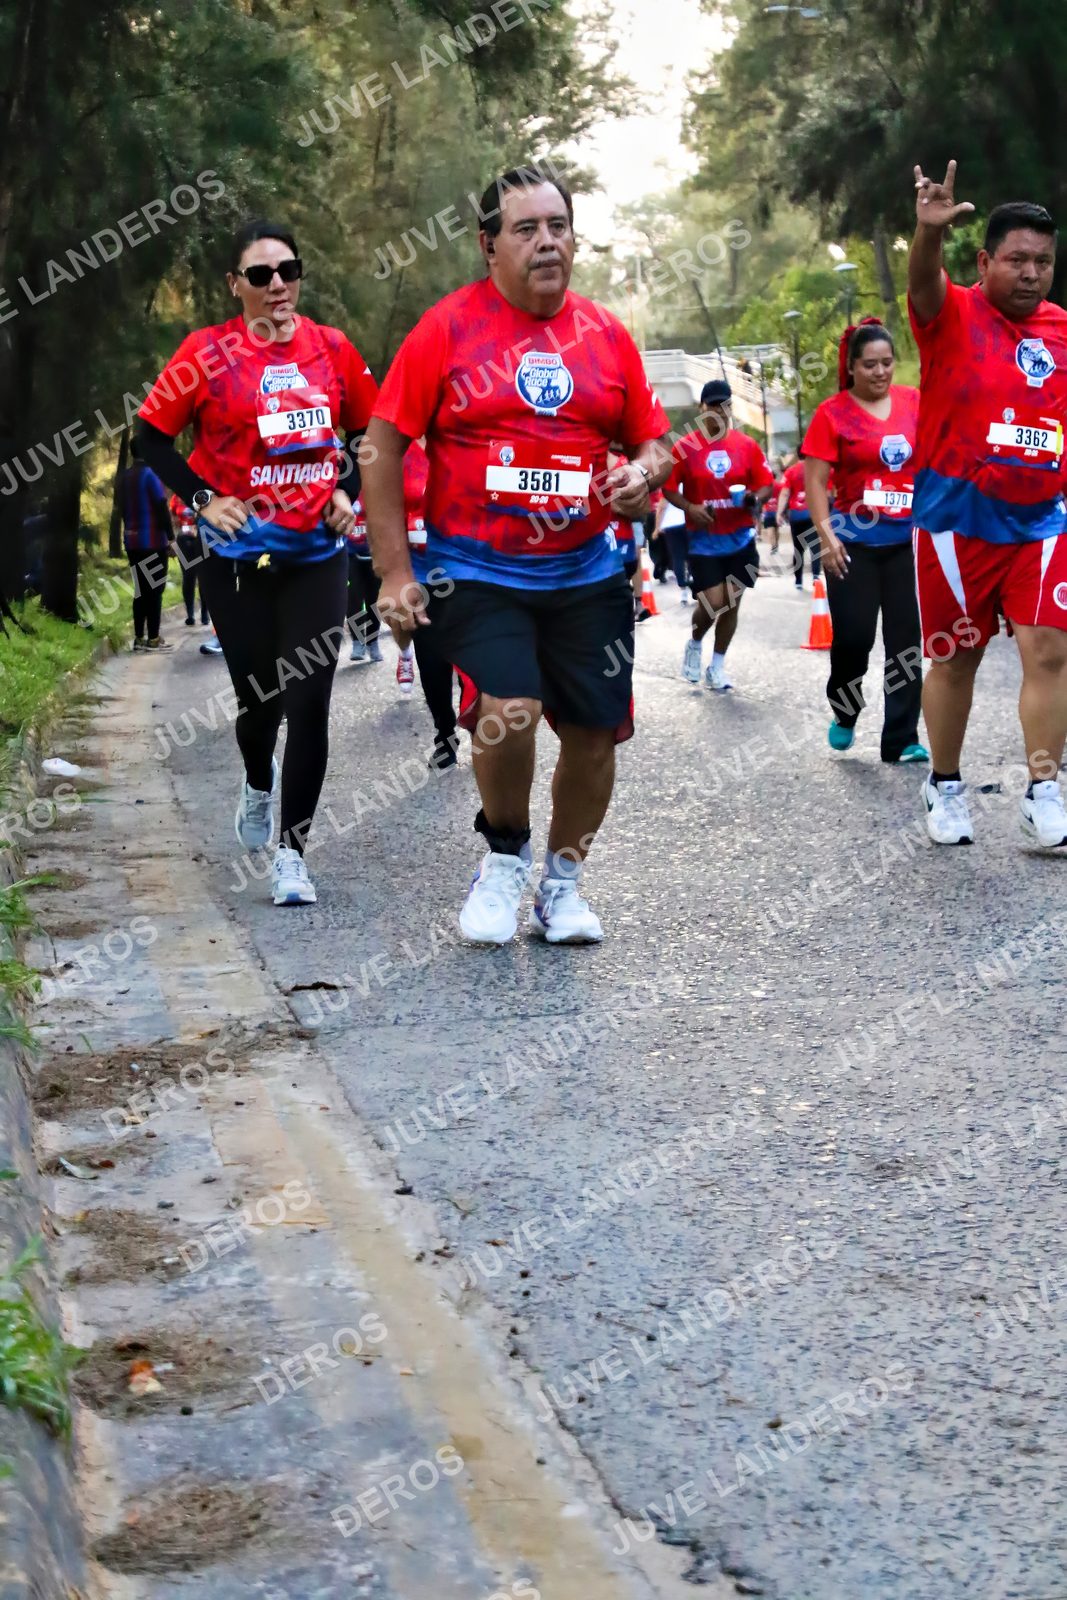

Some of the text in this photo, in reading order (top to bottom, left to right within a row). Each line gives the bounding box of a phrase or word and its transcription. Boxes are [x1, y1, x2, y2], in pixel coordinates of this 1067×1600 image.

[528, 357, 558, 365] BIMBO
[524, 376, 549, 387] Race
[529, 368, 559, 379] Global
[286, 408, 326, 431] 3370
[1015, 427, 1048, 449] 3362
[250, 461, 335, 487] SANTIAGO
[518, 470, 560, 493] 3581
[885, 492, 908, 506] 1370
